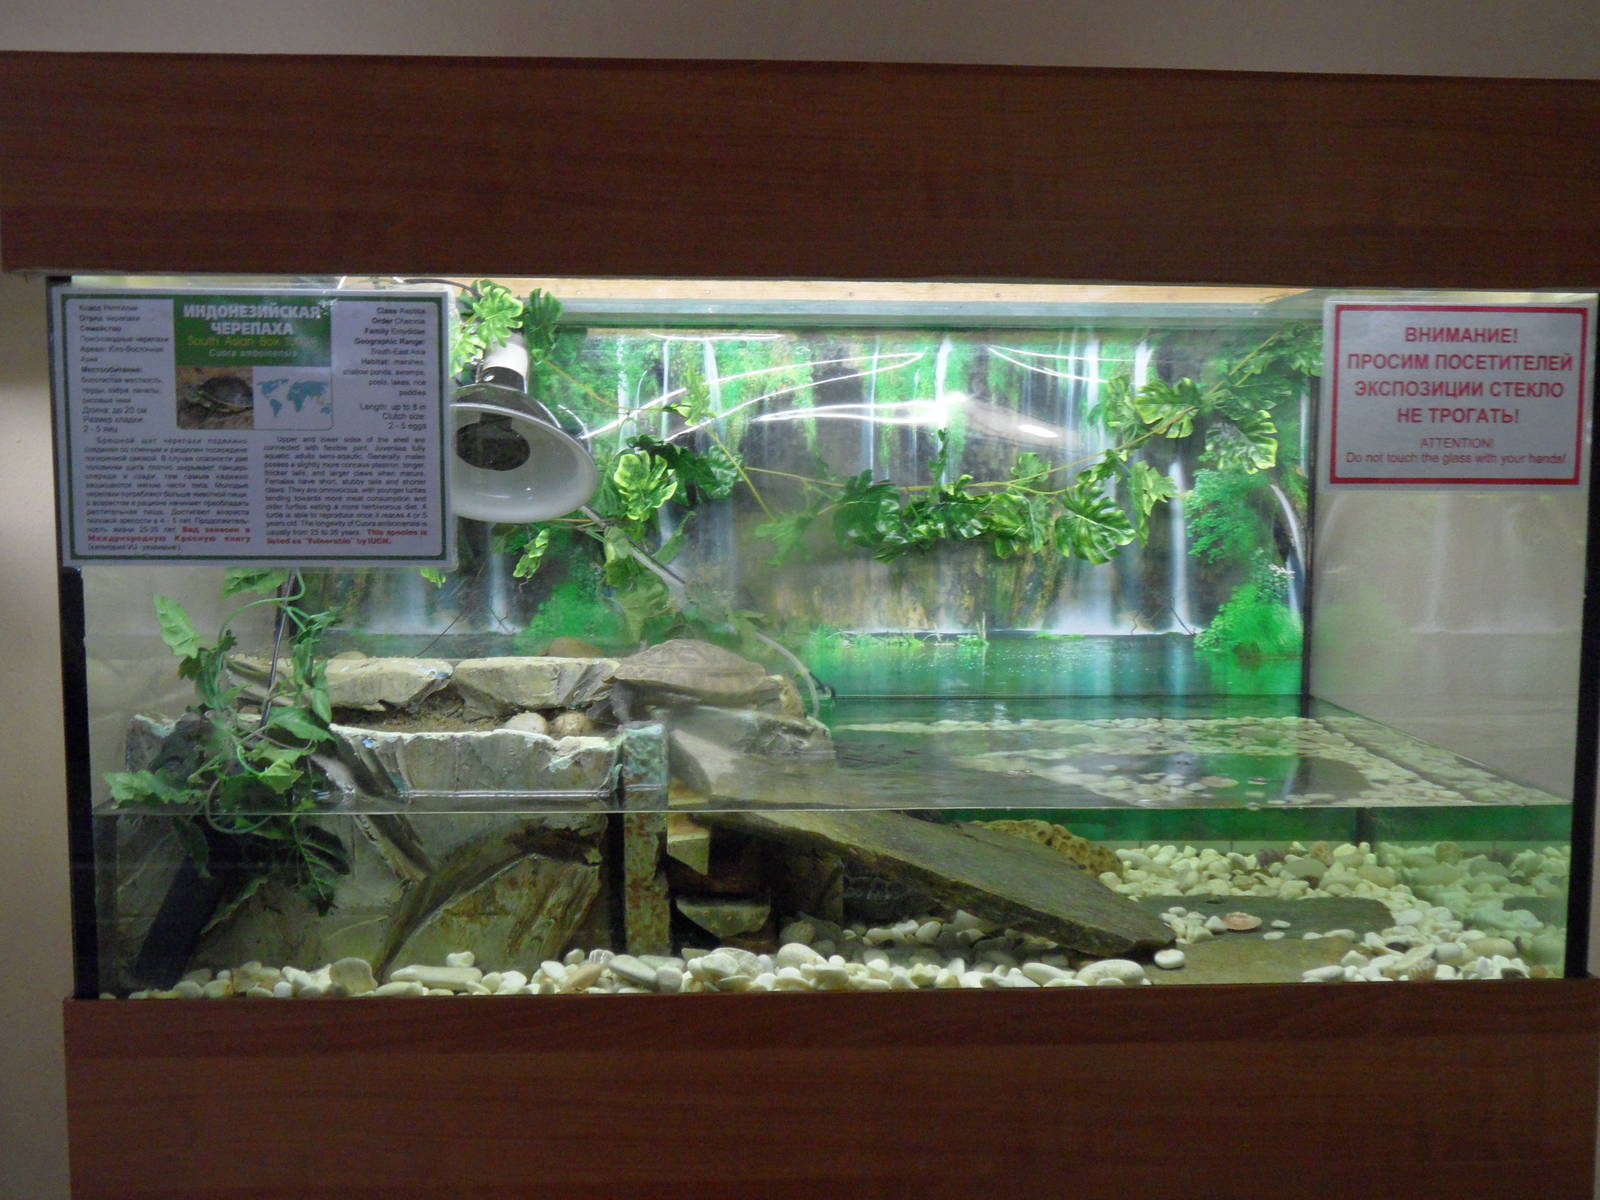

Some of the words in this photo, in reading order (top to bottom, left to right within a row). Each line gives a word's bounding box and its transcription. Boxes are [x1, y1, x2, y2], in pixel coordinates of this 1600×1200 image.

[184, 302, 320, 319] ИНДОНЕЗИЙСКАЯ
[211, 322, 294, 335] ЧЕРЕПАХА
[1405, 327, 1518, 343] ВНИМАНИЕ!
[260, 336, 280, 345] Box
[1347, 354, 1428, 370] ПРОСИМ
[1435, 353, 1573, 372] ПОСЕТИТЕЛЕЙ
[1354, 381, 1483, 399] ЭКСПОЗИЦИИ
[1490, 382, 1564, 398] СТЕКЛО
[1397, 408, 1422, 423] НЕ
[1429, 408, 1519, 423] ТРОГАТЬ!
[1346, 453, 1362, 463] Do
[1366, 453, 1383, 463] not
[1387, 453, 1417, 463] touch
[1422, 453, 1439, 463] the
[1442, 453, 1471, 465] glass
[1475, 453, 1496, 463] with
[1500, 454, 1525, 466] your
[1528, 453, 1567, 463] hands!
